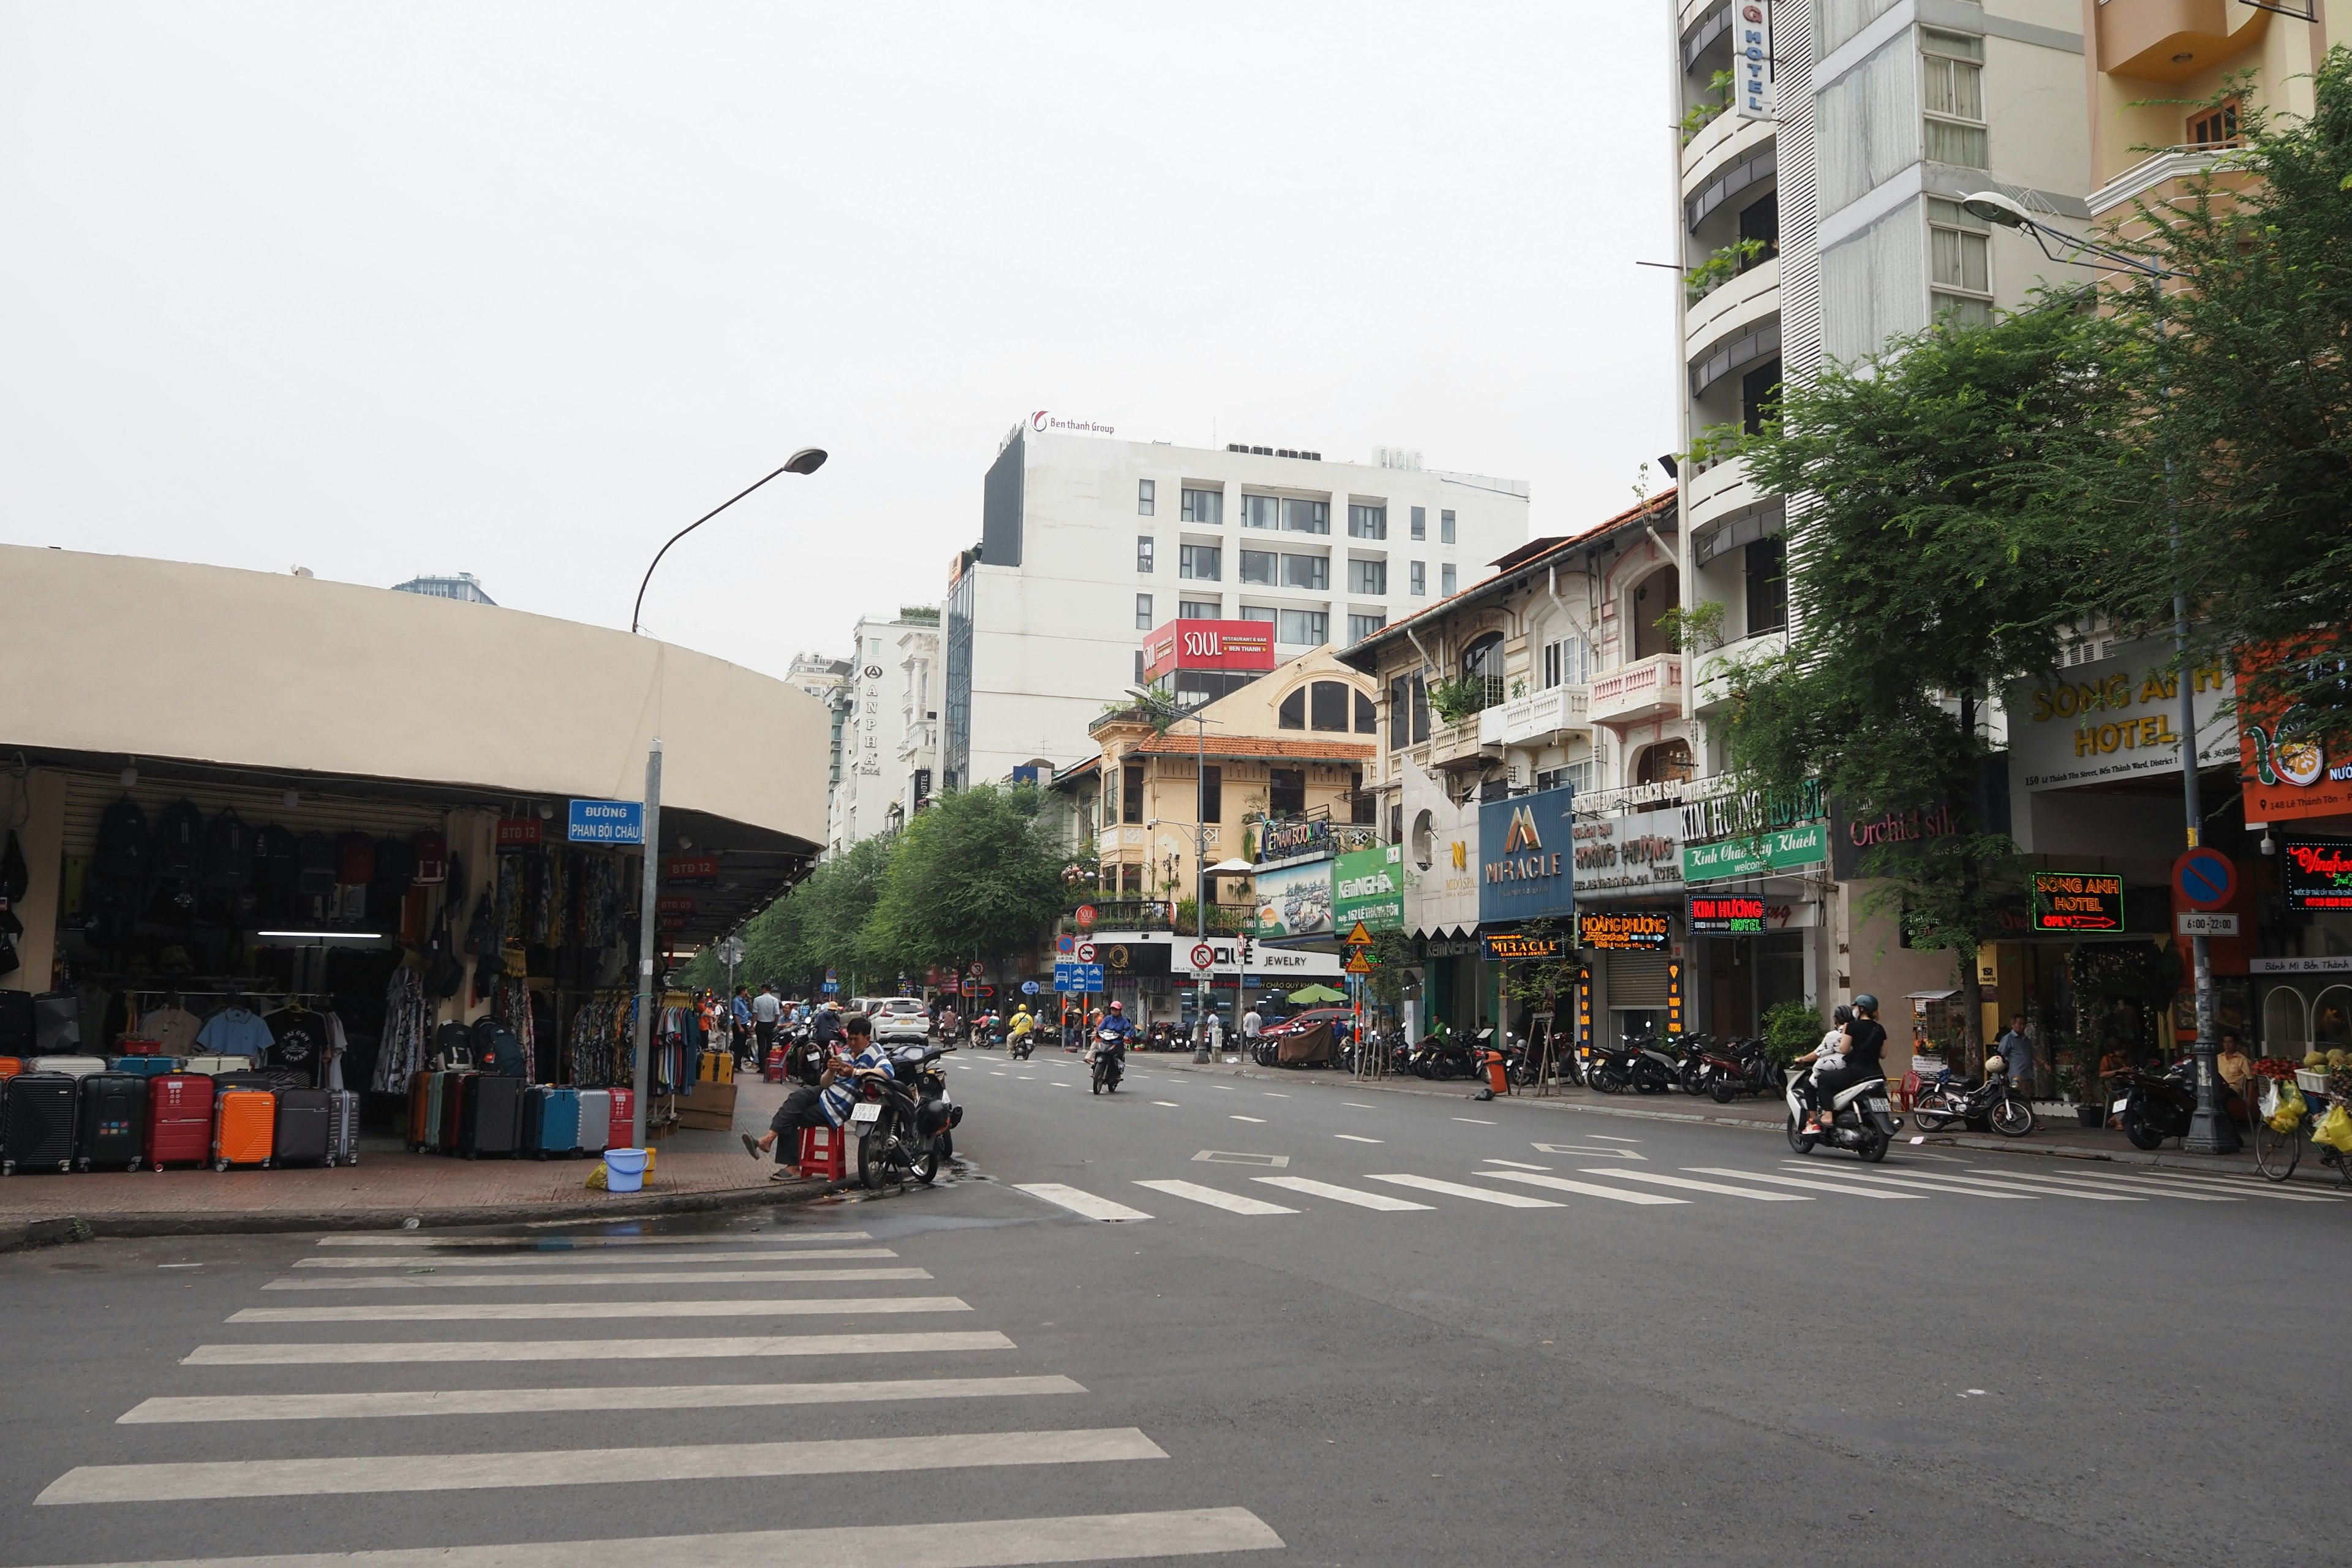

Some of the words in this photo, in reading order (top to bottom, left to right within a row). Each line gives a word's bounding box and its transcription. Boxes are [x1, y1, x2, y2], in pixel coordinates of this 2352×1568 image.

[1746, 30, 1763, 111] HOTEL
[1050, 418, 1065, 428] Ben
[1067, 419, 1090, 431] thanh
[1092, 422, 1114, 435] Group
[1184, 631, 1222, 656] SOUL
[2032, 673, 2132, 722] SONG
[864, 685, 878, 765] ANPHA
[2075, 714, 2177, 757] HOTEL
[861, 767, 881, 776] Hotel
[2025, 776, 2038, 786] 150
[2049, 774, 2067, 783] Thánh
[2081, 769, 2098, 778] Street,
[2100, 766, 2111, 775] Bến
[2112, 762, 2131, 774] Thành
[2150, 757, 2173, 767] District
[2271, 801, 2285, 810] 148
[2286, 798, 2296, 808] Lê
[2297, 796, 2322, 807] Thánh
[2323, 795, 2338, 805] Tôn
[585, 807, 627, 818] ĐƯỜNG
[1679, 802, 1708, 842] KIM
[1850, 810, 1921, 846] Orchid
[502, 827, 521, 839] BTĐ
[525, 826, 535, 839] 12
[571, 824, 596, 837] PHAN
[598, 823, 612, 840] BỘI
[615, 823, 639, 839] CHÂU
[1776, 830, 1817, 853] Khách
[1575, 839, 1616, 869] HOÀNG
[1621, 834, 1674, 869] PHƯỢNG
[673, 864, 695, 873] BTĐ
[699, 863, 710, 872] 12
[1486, 853, 1561, 884] MIRACLE
[1735, 860, 1768, 873] welcome
[2037, 876, 2082, 893] SONG
[2085, 878, 2119, 894] ANH
[1693, 901, 1715, 918] KIM
[1718, 899, 1763, 918] HƯƠNG
[2055, 897, 2103, 912] HOTEL
[1080, 910, 1093, 918] SOUL
[1348, 909, 1358, 921] 162
[1358, 906, 1365, 919] LÊ
[2043, 916, 2071, 927] OPEN
[1259, 919, 1275, 929] VIETNAM
[1581, 914, 1621, 932] HOÀNG
[1622, 915, 1667, 934] PHƯỢNG
[1730, 919, 1762, 931] HOTEL
[1582, 932, 1630, 941] Hotel
[1491, 941, 1556, 952] MIRACLE
[1264, 956, 1306, 966] JEWELRY
[2304, 960, 2318, 970] Bến
[2321, 960, 2349, 969] Thành
